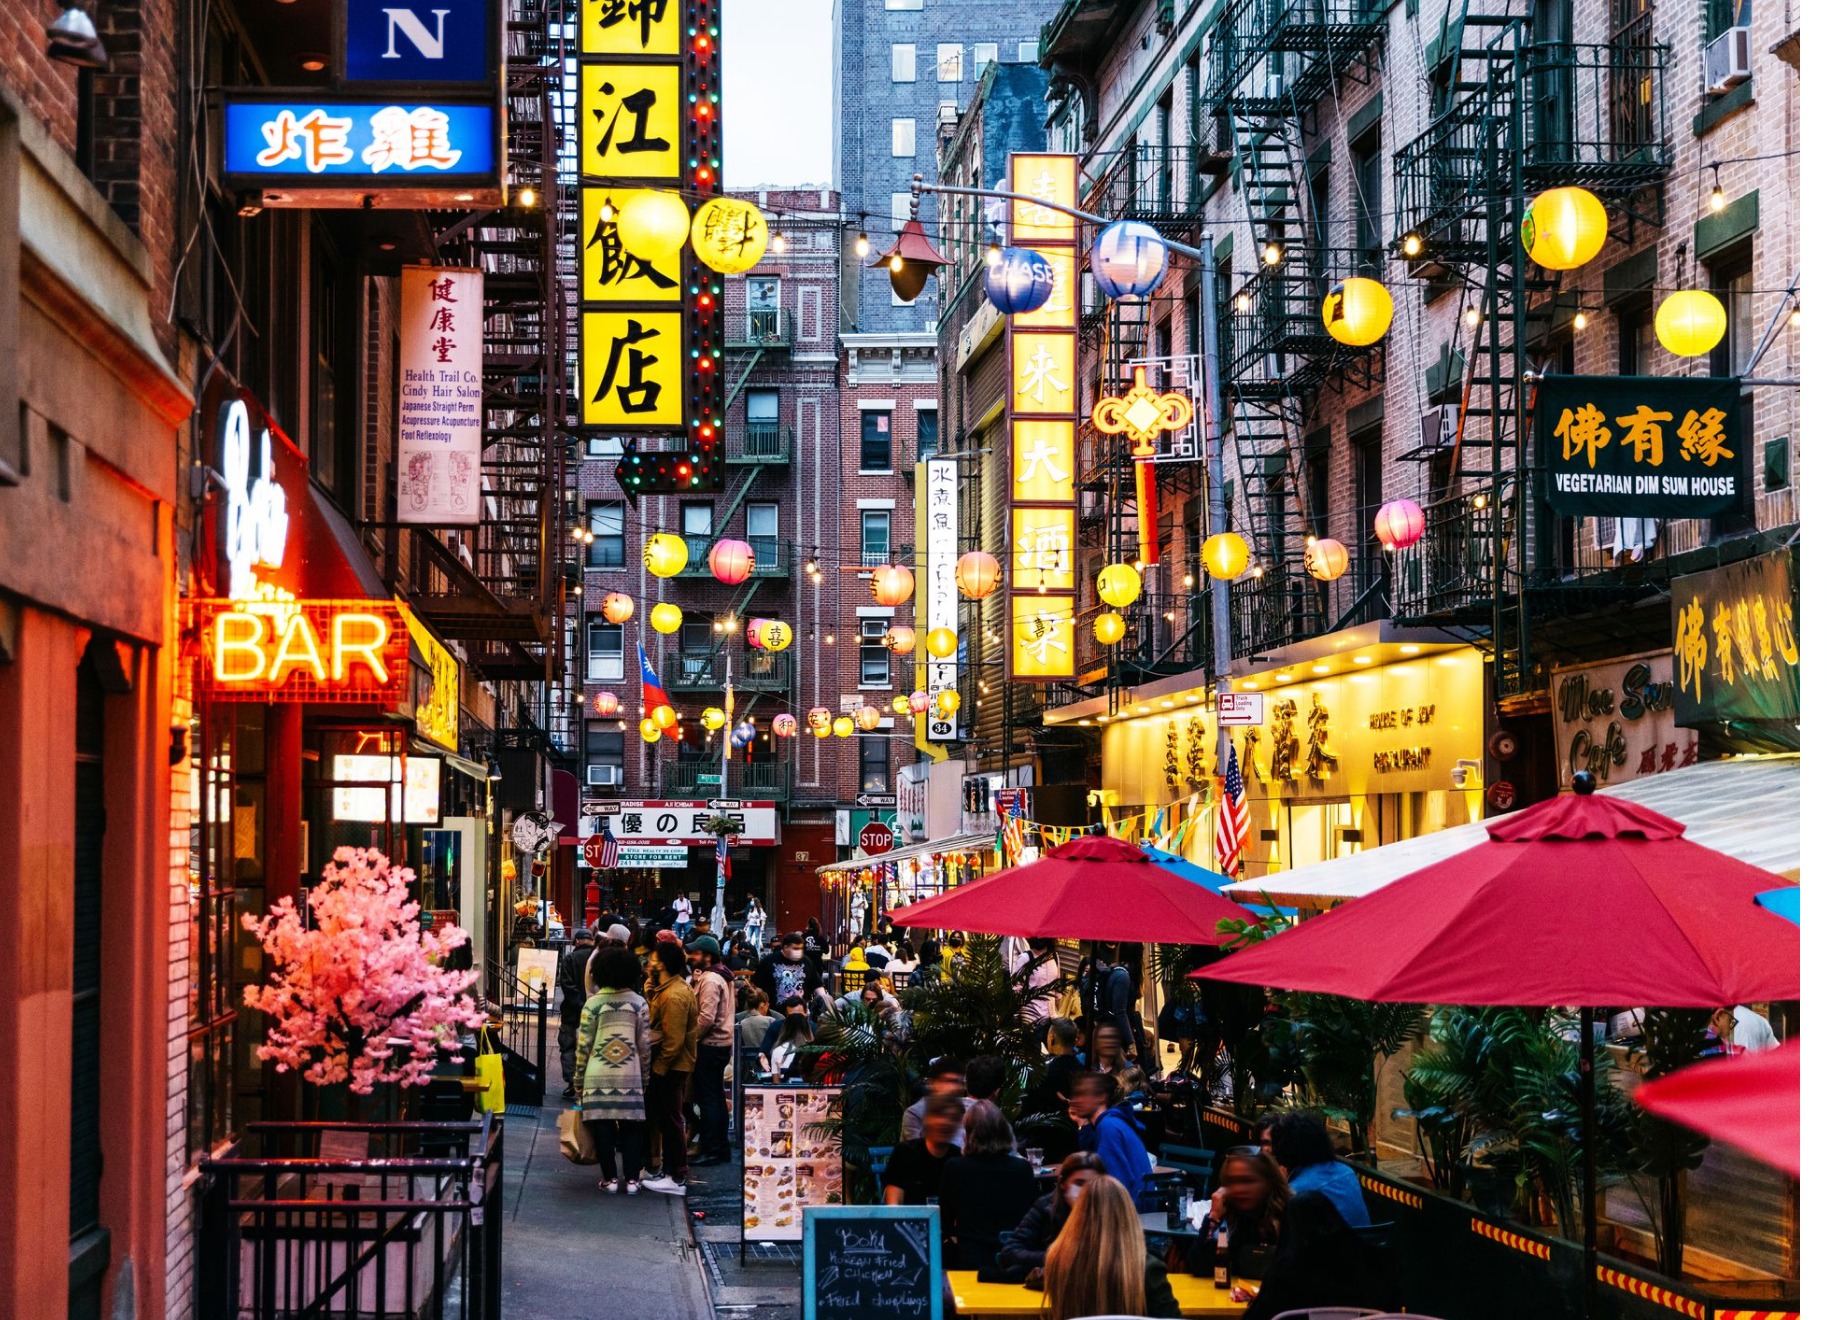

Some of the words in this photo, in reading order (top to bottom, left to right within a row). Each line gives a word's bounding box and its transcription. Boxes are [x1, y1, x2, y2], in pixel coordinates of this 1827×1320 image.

[381, 8, 450, 59] N
[427, 278, 459, 363] 健康堂
[405, 369, 435, 383] Health
[439, 369, 460, 383] Trail
[463, 370, 478, 383] Co.
[402, 384, 429, 398] Cindy
[432, 385, 452, 397] Hair
[456, 386, 480, 398] Salon
[401, 401, 431, 412] Japanese
[432, 401, 457, 412] Straight
[458, 401, 475, 412] Perm
[401, 415, 440, 427] Acupressure
[441, 416, 480, 427] Acupuncture
[401, 430, 415, 441] Foot
[416, 430, 452, 443] Reflexology
[1553, 403, 1735, 468] 佛有緣
[1555, 472, 1633, 494] VEGETARIAN
[1635, 474, 1660, 495] DIM
[1662, 475, 1689, 496] SUM
[1691, 476, 1735, 497] HOUSE
[213, 611, 389, 683] BAR
[934, 723, 949, 734] 34
[603, 805, 618, 813] WAY
[861, 832, 892, 847] STOP
[585, 844, 600, 858] ST
